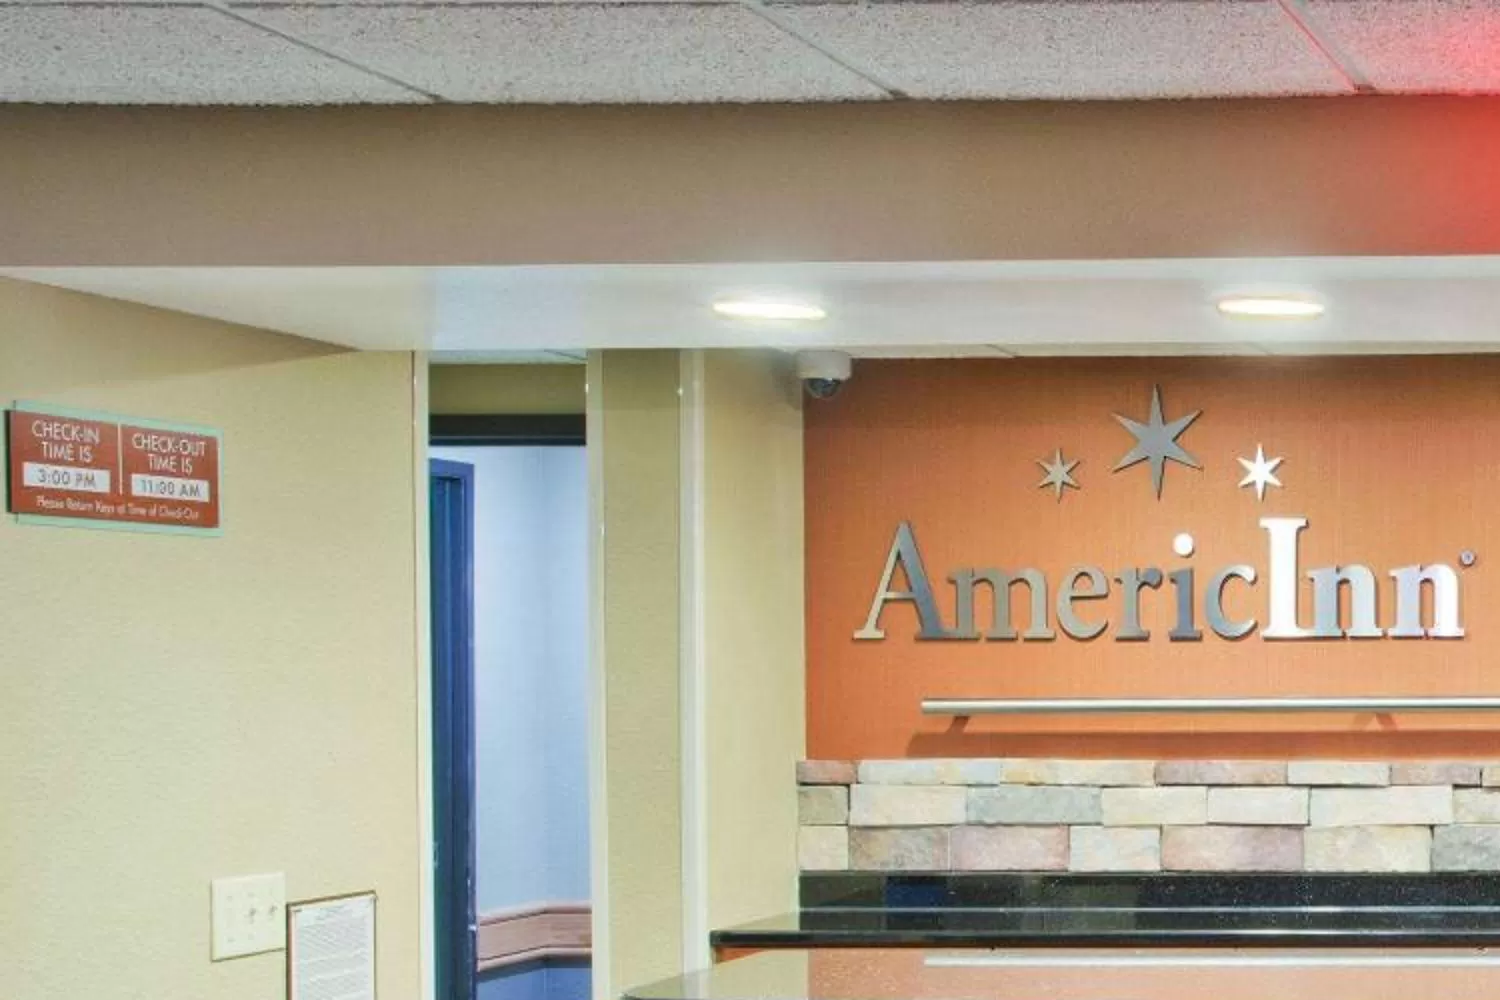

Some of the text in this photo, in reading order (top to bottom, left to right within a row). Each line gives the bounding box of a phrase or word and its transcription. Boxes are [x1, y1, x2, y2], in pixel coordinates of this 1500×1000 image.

[32, 420, 99, 444] CHECK-IN
[41, 441, 93, 462] TIME IS
[132, 433, 206, 456] CHECK-OUT
[148, 454, 193, 474] TIME IS
[38, 469, 96, 489] 3:00 PM
[141, 479, 200, 497] 11:00 AM
[853, 516, 1465, 641] AmericInn
